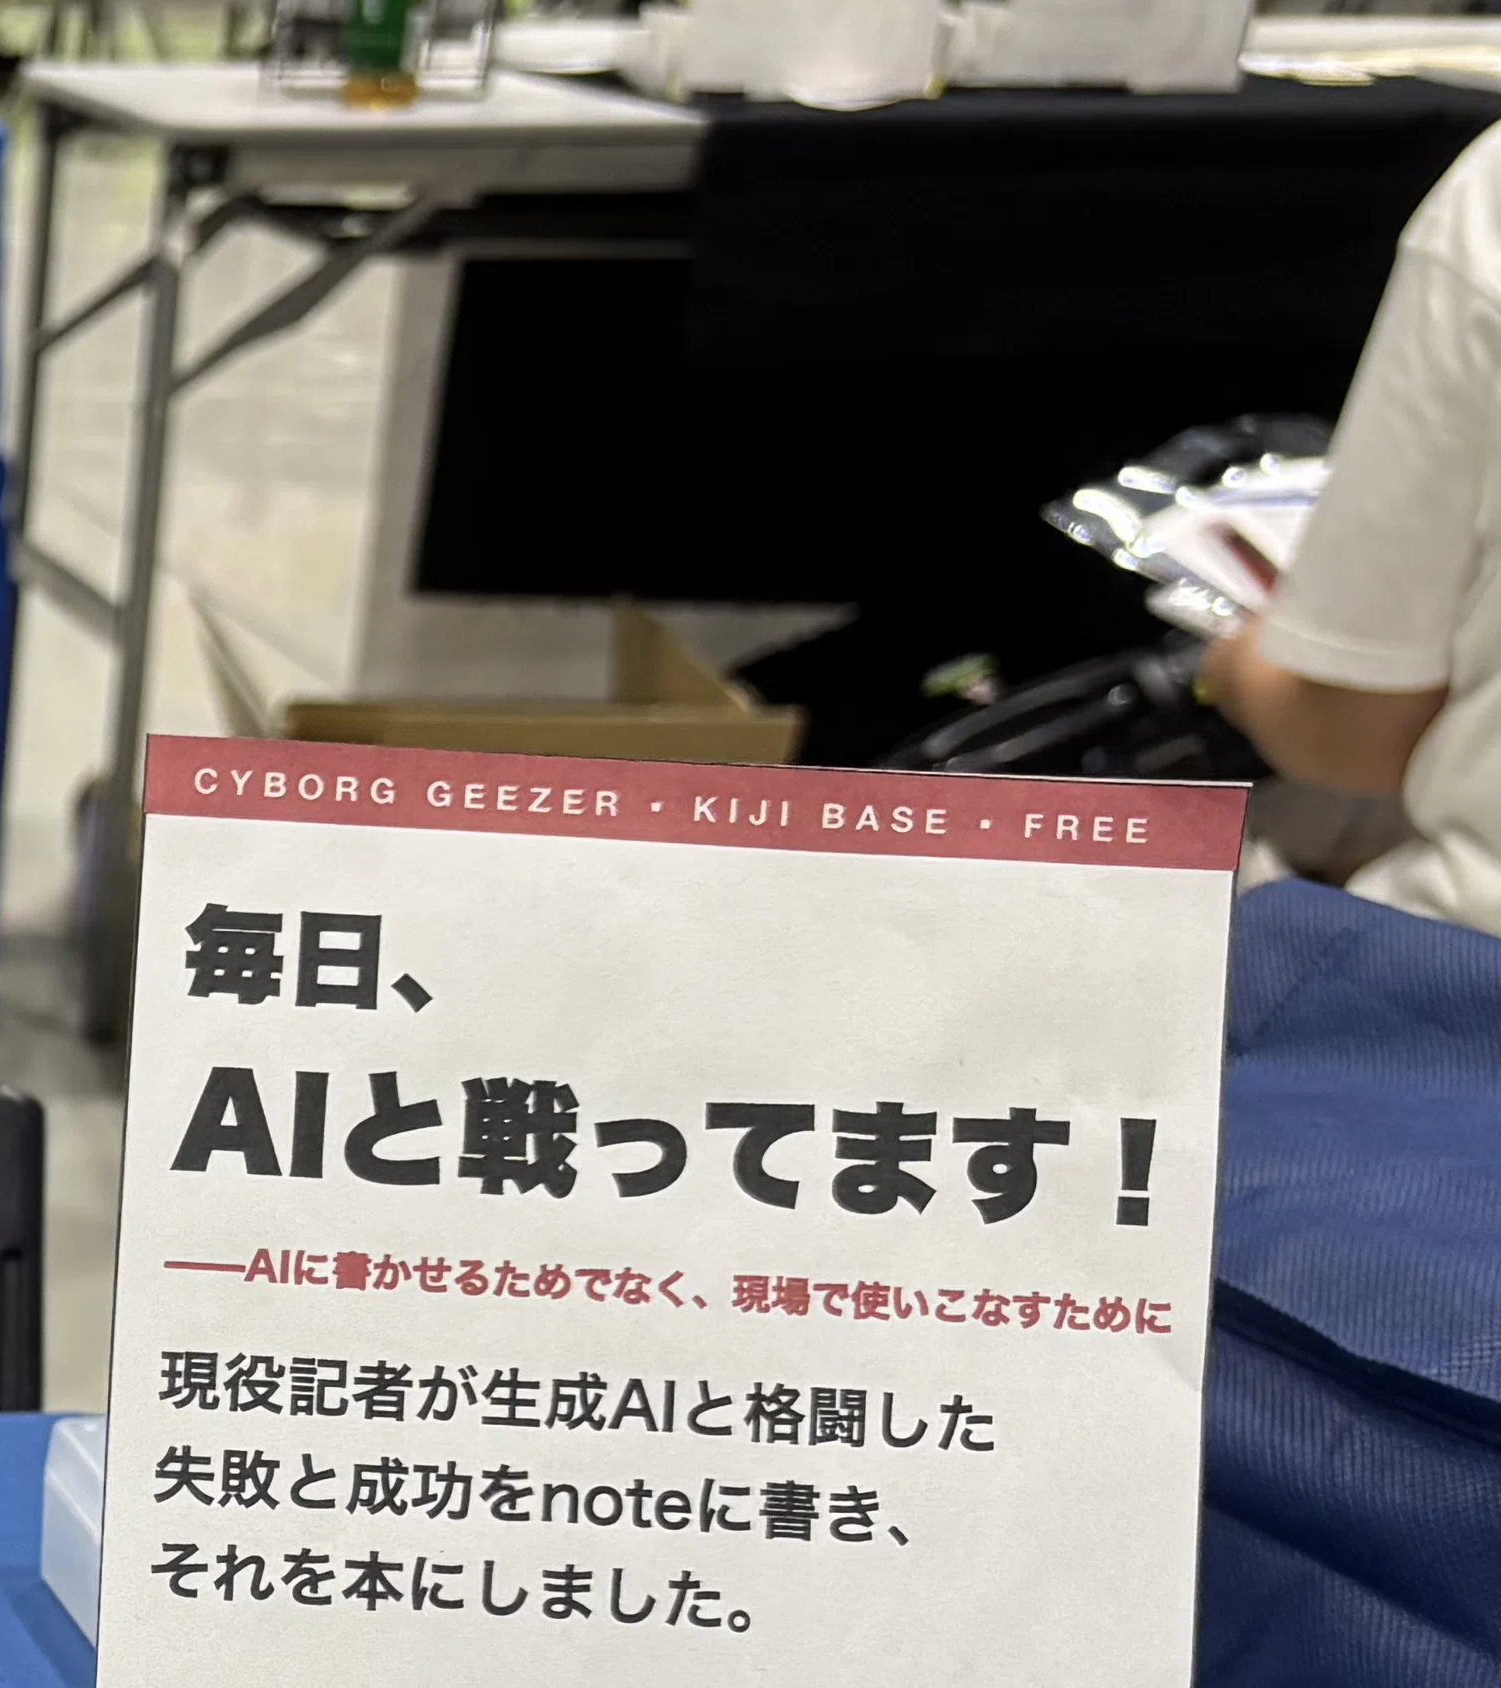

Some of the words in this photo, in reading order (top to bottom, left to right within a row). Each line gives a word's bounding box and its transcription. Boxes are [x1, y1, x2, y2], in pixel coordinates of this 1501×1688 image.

[195, 768, 394, 804] CYBORG
[427, 781, 617, 816] GEEZER
[694, 796, 788, 826] KIJI
[823, 803, 946, 834] BASE
[1025, 814, 1147, 843] FREE
[185, 903, 433, 1012] 毎日、
[170, 1067, 1156, 1226] AIと戦ってます！
[159, 1351, 994, 1451] 現役記者が生成AIと格闘した
[154, 1445, 908, 1545] 失敗と成功をnoteに書き、
[151, 1543, 750, 1632] それを本にしました。
